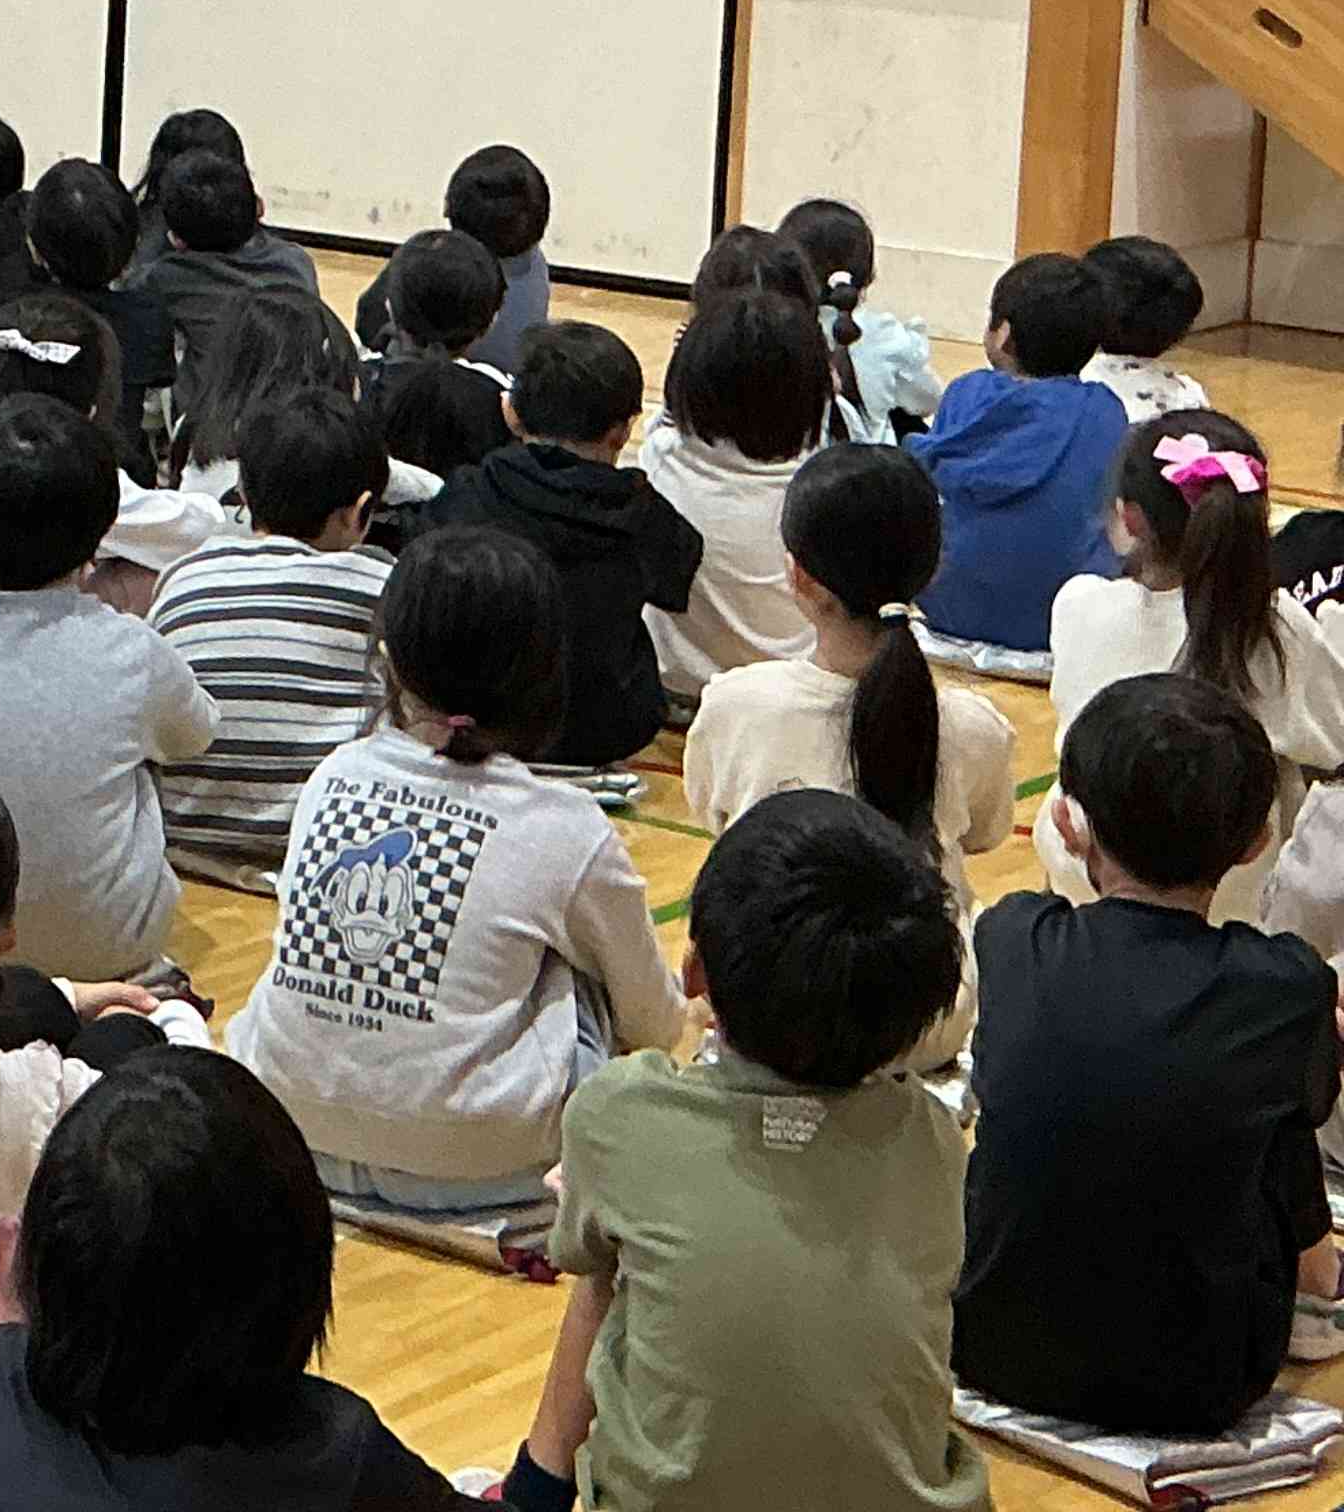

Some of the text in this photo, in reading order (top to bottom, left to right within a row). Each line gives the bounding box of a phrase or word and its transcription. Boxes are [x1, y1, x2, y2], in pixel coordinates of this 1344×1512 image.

[324, 777, 498, 829] The Fabulous
[272, 966, 434, 1022] Donald Duck
[305, 1002, 383, 1032] Since 1934
